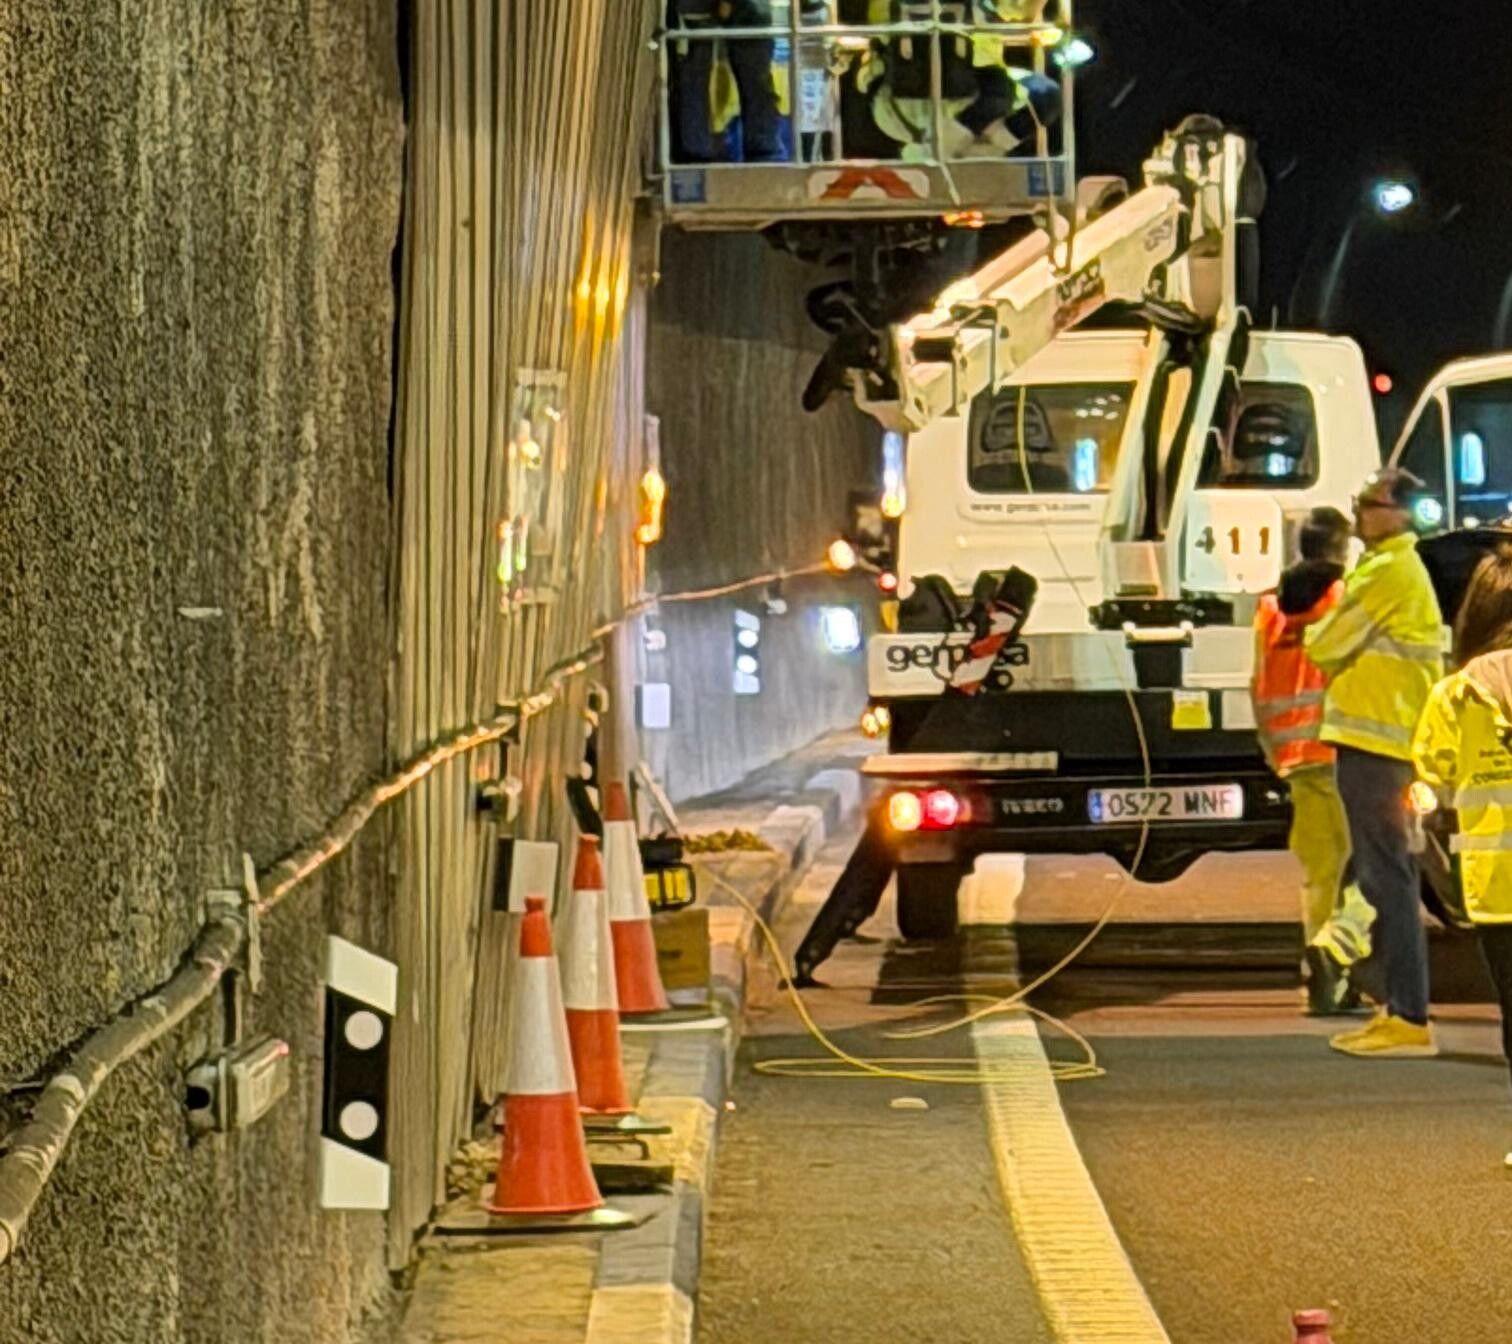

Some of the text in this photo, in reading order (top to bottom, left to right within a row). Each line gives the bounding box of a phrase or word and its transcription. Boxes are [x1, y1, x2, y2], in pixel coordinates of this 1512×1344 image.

[1195, 526, 1269, 555] 411
[1108, 789, 1233, 817] 0572 MNF
